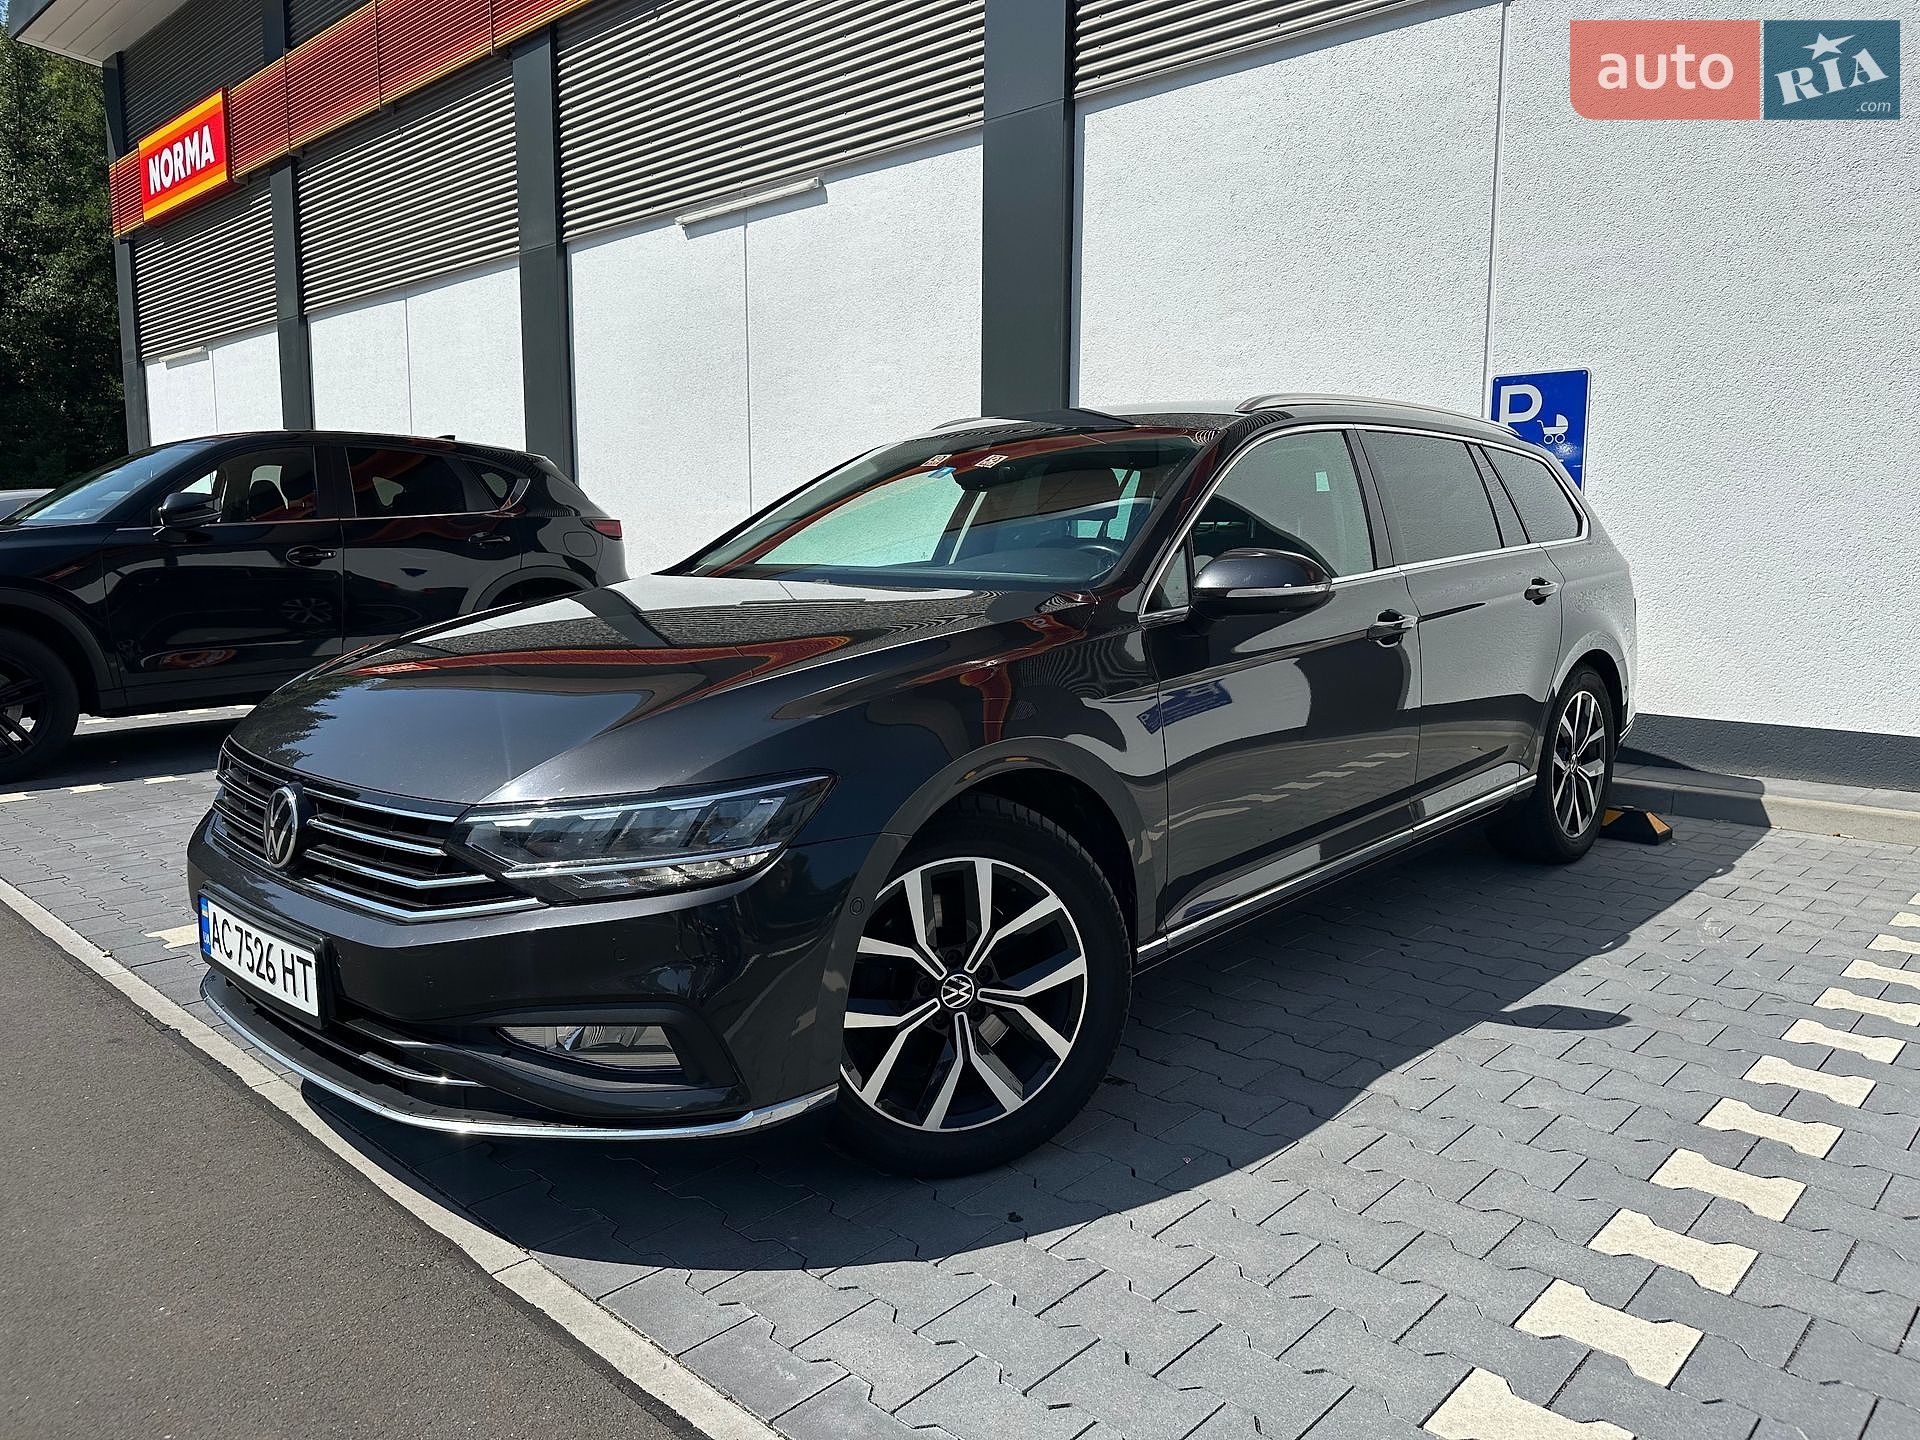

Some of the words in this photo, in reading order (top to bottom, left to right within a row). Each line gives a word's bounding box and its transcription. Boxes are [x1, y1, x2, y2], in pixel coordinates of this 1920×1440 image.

[148, 124, 215, 196] NORMA
[1499, 384, 1543, 429] P
[212, 911, 233, 960] AC
[234, 924, 277, 985] 7526
[281, 948, 313, 1003] HT
